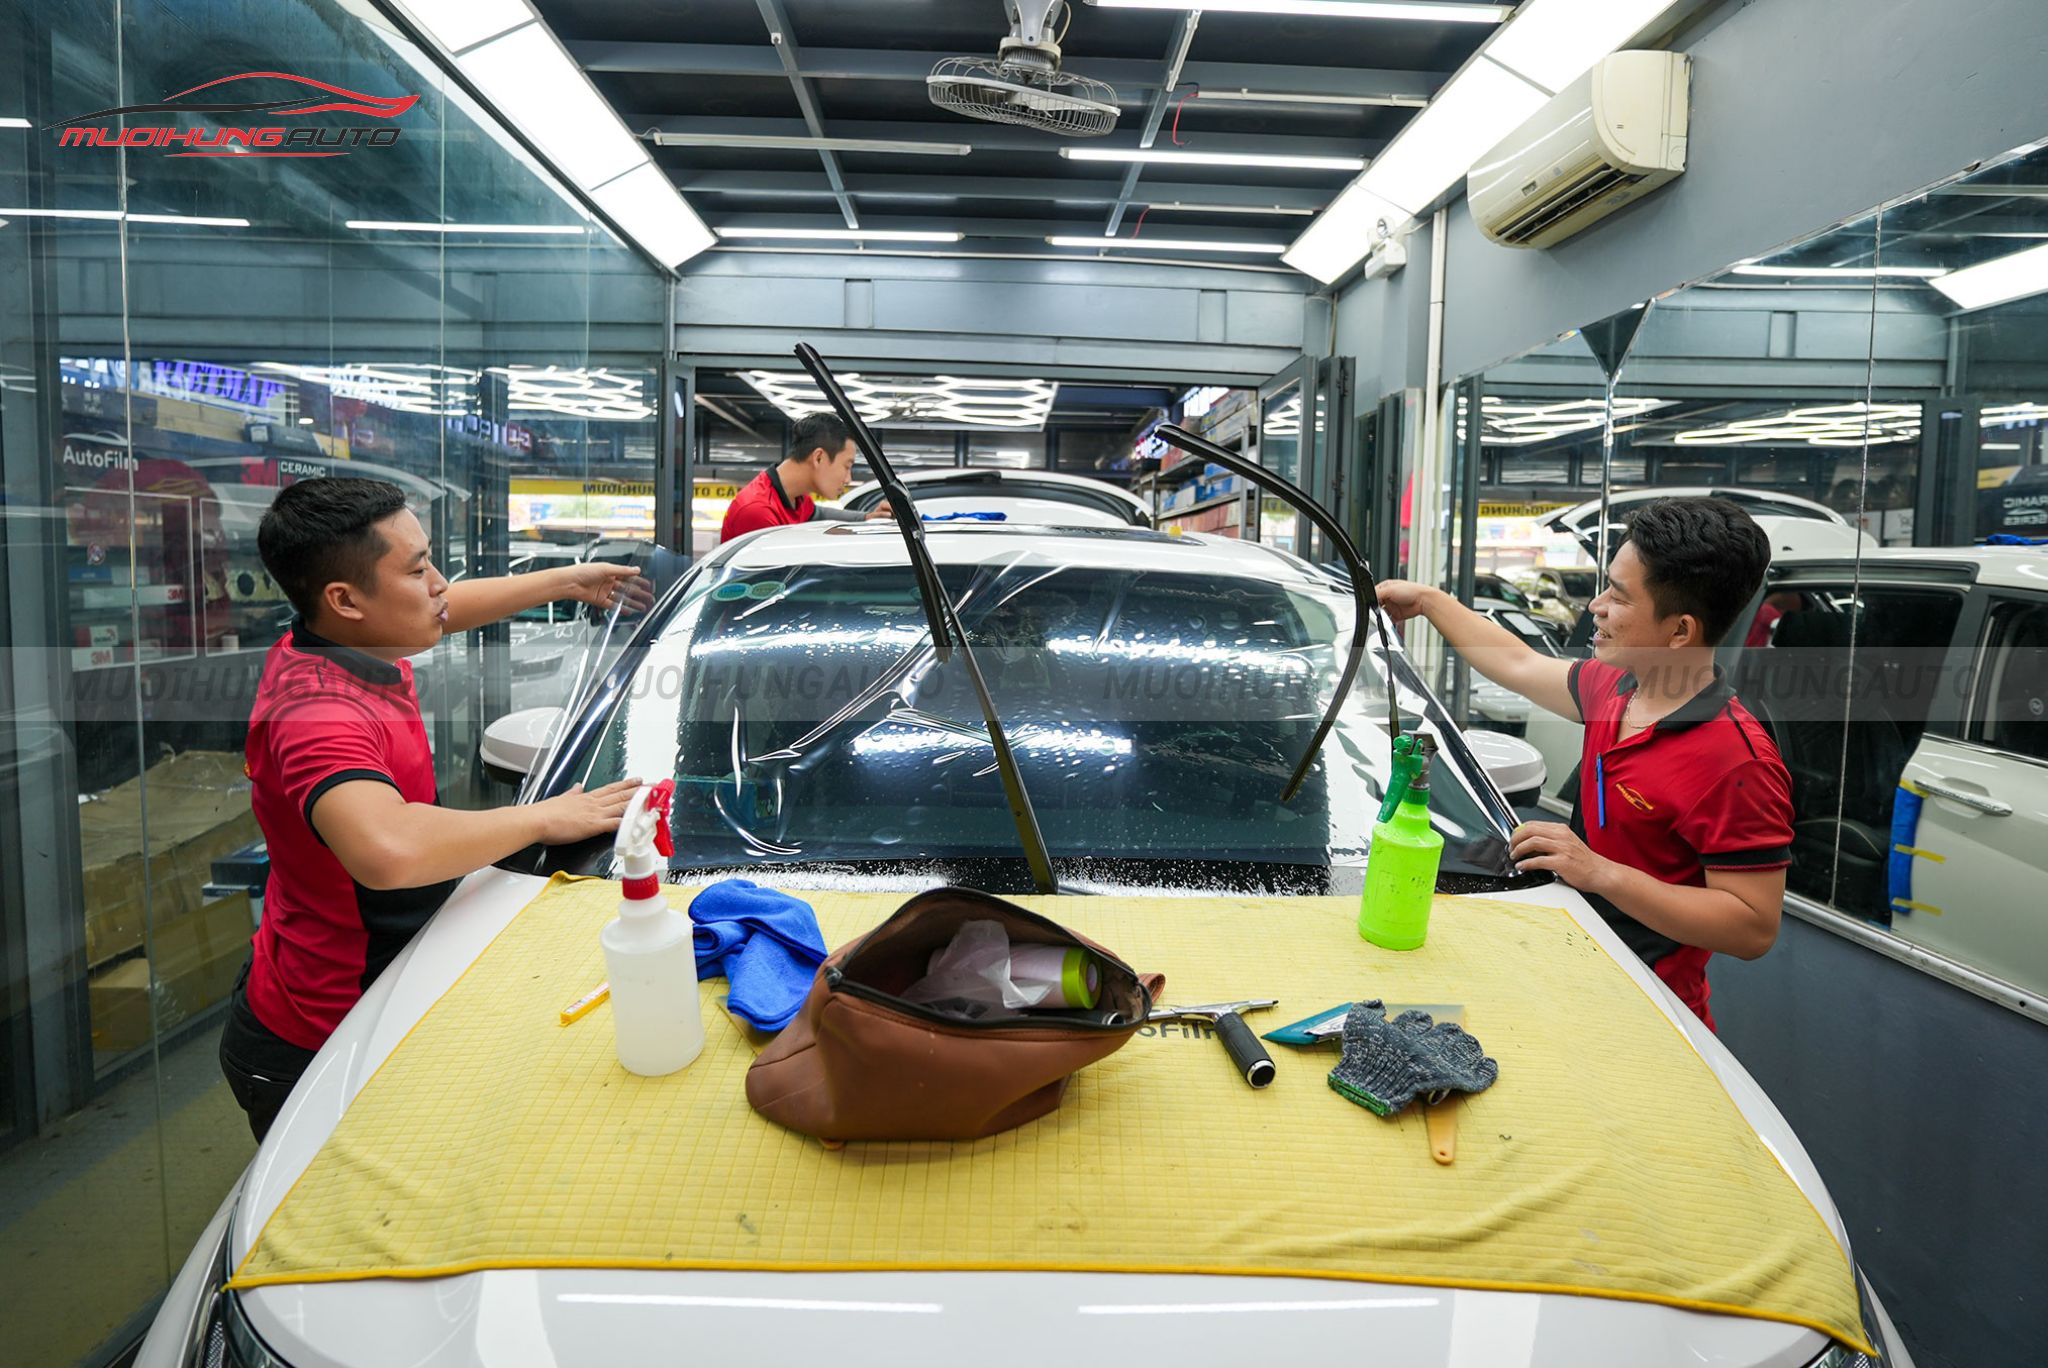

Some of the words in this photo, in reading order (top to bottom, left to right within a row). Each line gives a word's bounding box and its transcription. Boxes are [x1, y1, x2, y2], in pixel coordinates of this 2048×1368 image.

[63, 444, 139, 472] AutoFilm
[241, 456, 278, 488] 3M
[280, 460, 327, 478] CERAMIC
[167, 588, 185, 600] 3M
[90, 651, 113, 666] 3M
